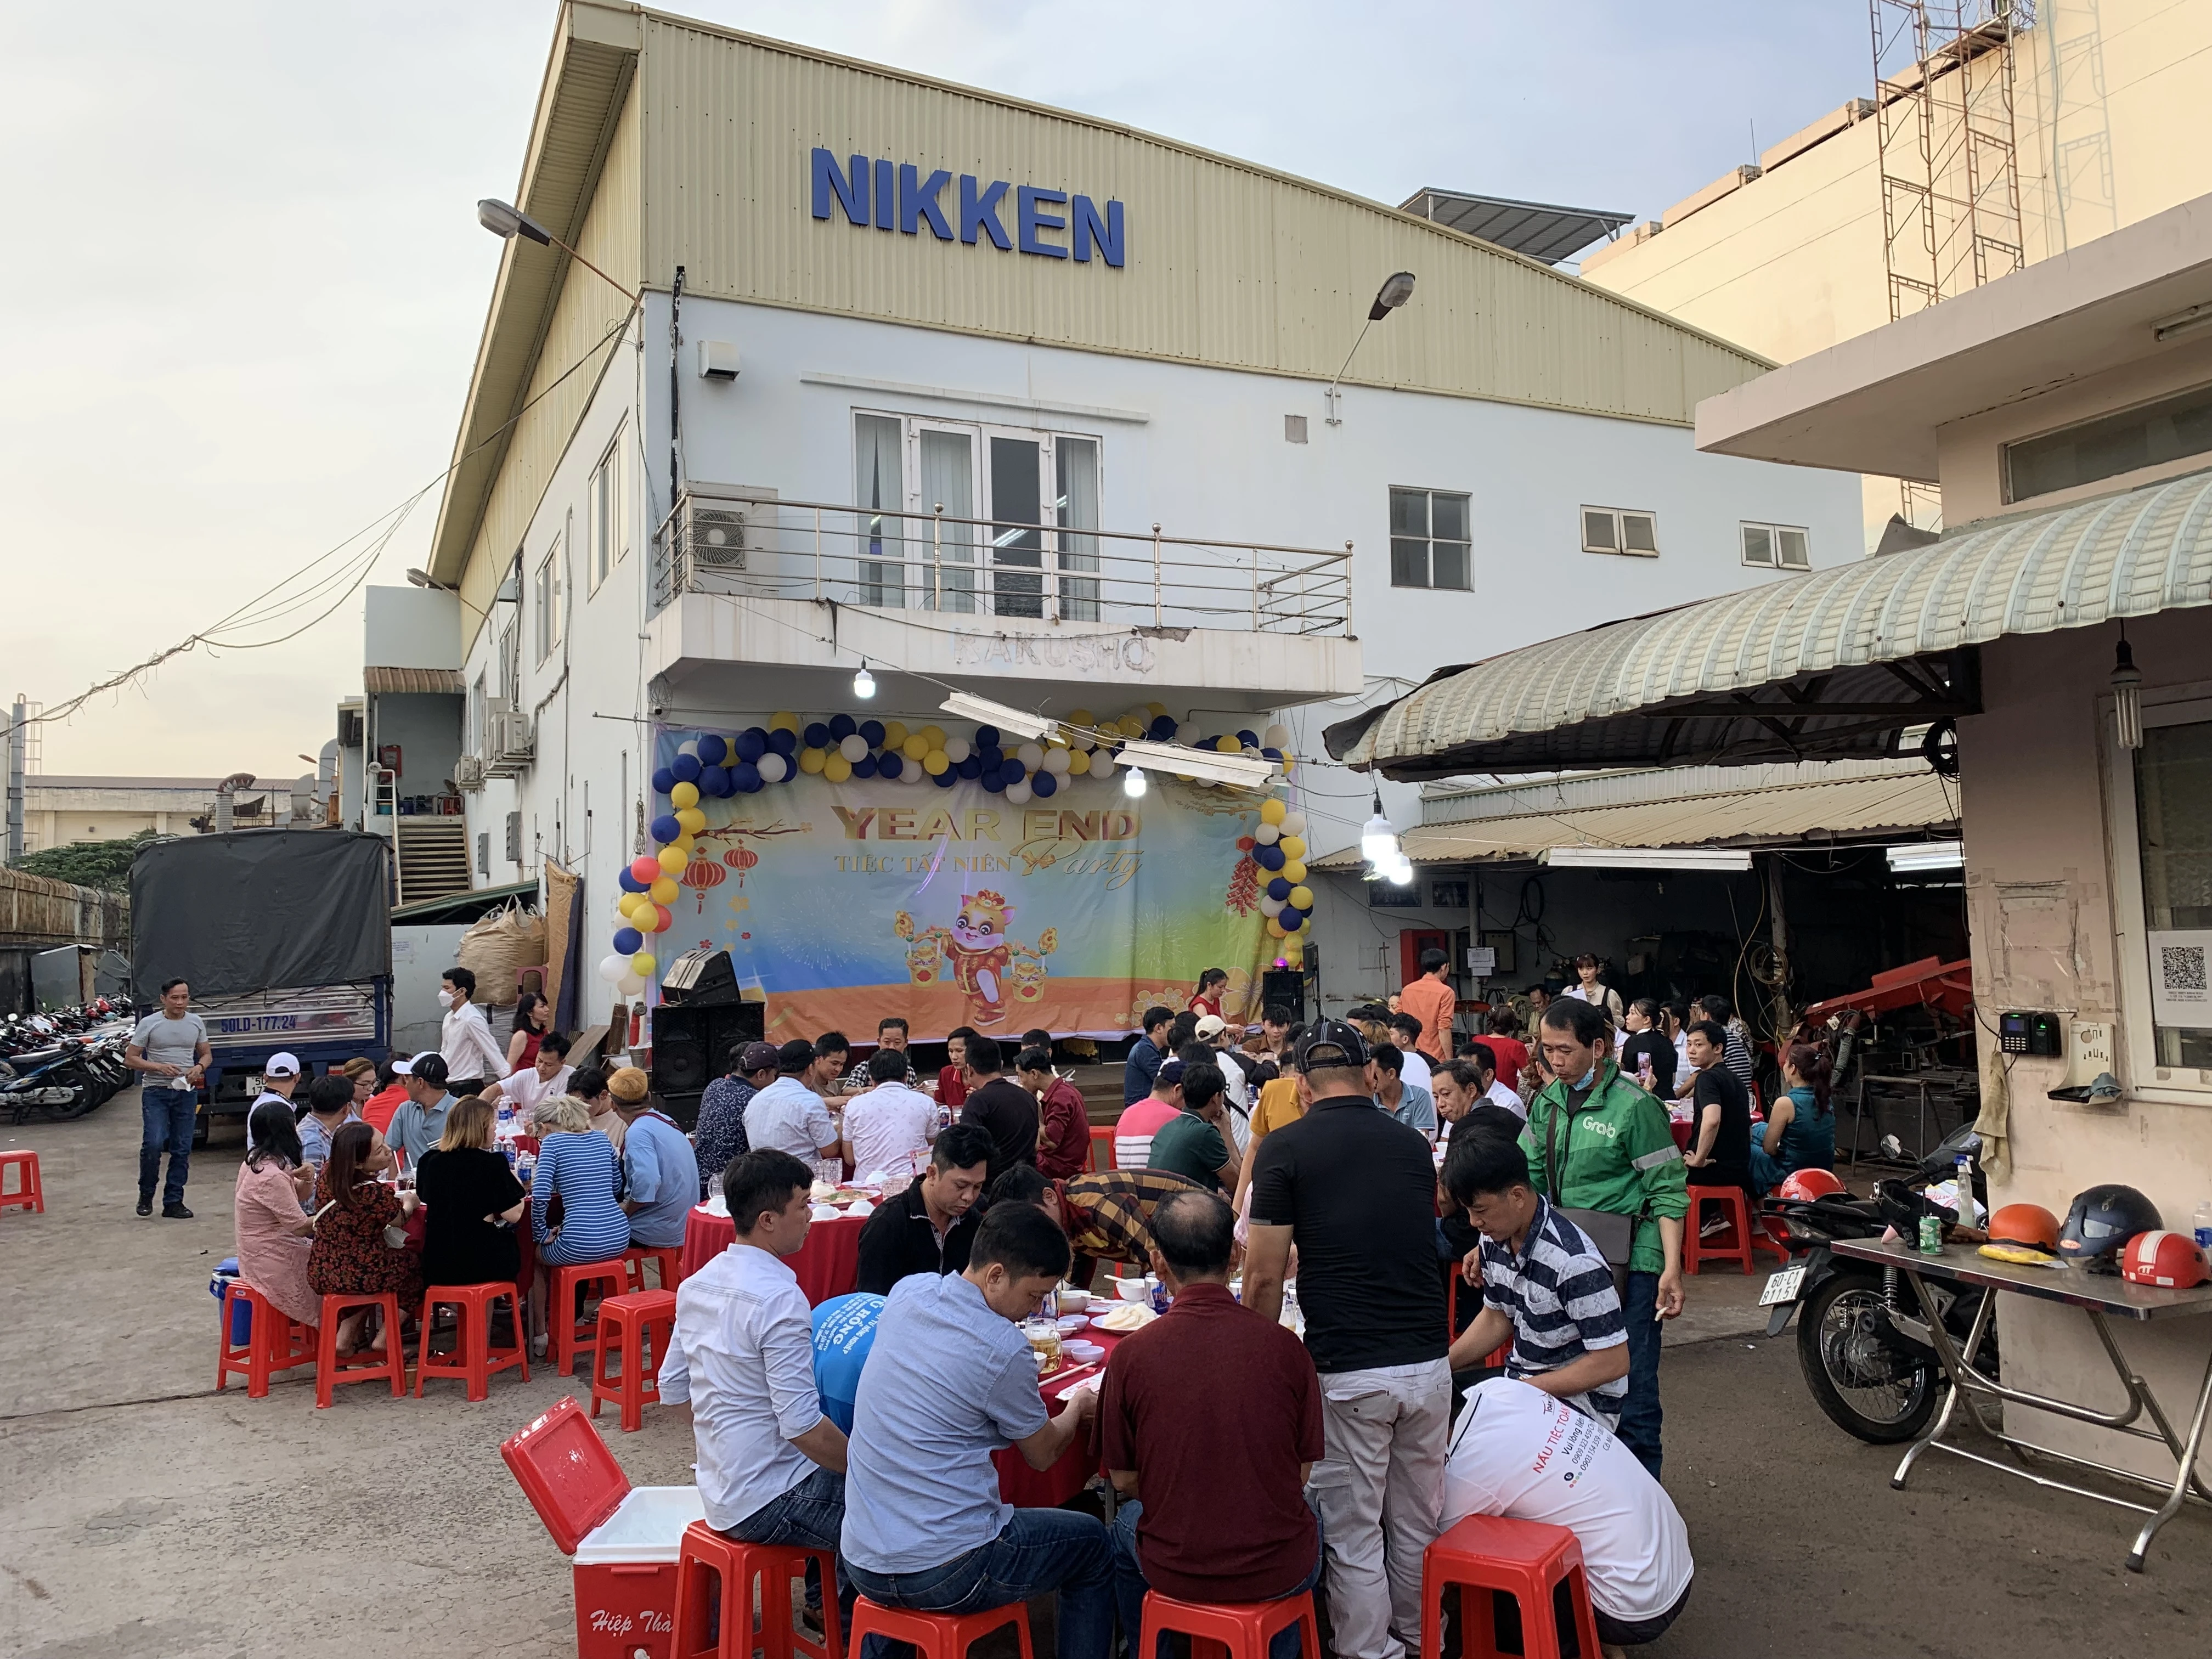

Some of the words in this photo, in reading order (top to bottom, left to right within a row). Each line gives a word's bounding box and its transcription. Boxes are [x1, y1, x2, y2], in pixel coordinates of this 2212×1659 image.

[812, 147, 1124, 268] NIKKEN
[953, 627, 1155, 674] KAKUSHO
[830, 805, 1002, 841] YEAR
[1022, 808, 1143, 841] END
[834, 852, 894, 876] TIỆC
[900, 850, 945, 873] TẤT
[952, 853, 1013, 872] NIÊN
[1009, 836, 1145, 890] Party
[221, 1014, 296, 1033] 50LD-177.24
[1582, 1116, 1616, 1138] Grab
[1761, 1284, 1797, 1304] 811.51
[833, 1308, 871, 1345] HỒNG
[856, 1325, 871, 1337] NÔNG
[842, 1336, 859, 1355] NGHIỆP
[1532, 1446, 1553, 1474] NẤU
[1547, 1425, 1564, 1445] TIỆC
[1561, 1441, 1575, 1455] Vui
[1567, 1427, 1583, 1443] lòng
[1572, 1448, 1584, 1464] 0909
[1579, 1438, 1588, 1450] 323
[1584, 1429, 1593, 1440] 459
[1580, 1454, 1593, 1471] 0903
[1588, 1444, 1596, 1456] 154
[1592, 1435, 1601, 1447] 359
[590, 1610, 633, 1637] Hiệp
[639, 1610, 674, 1633] Thà
